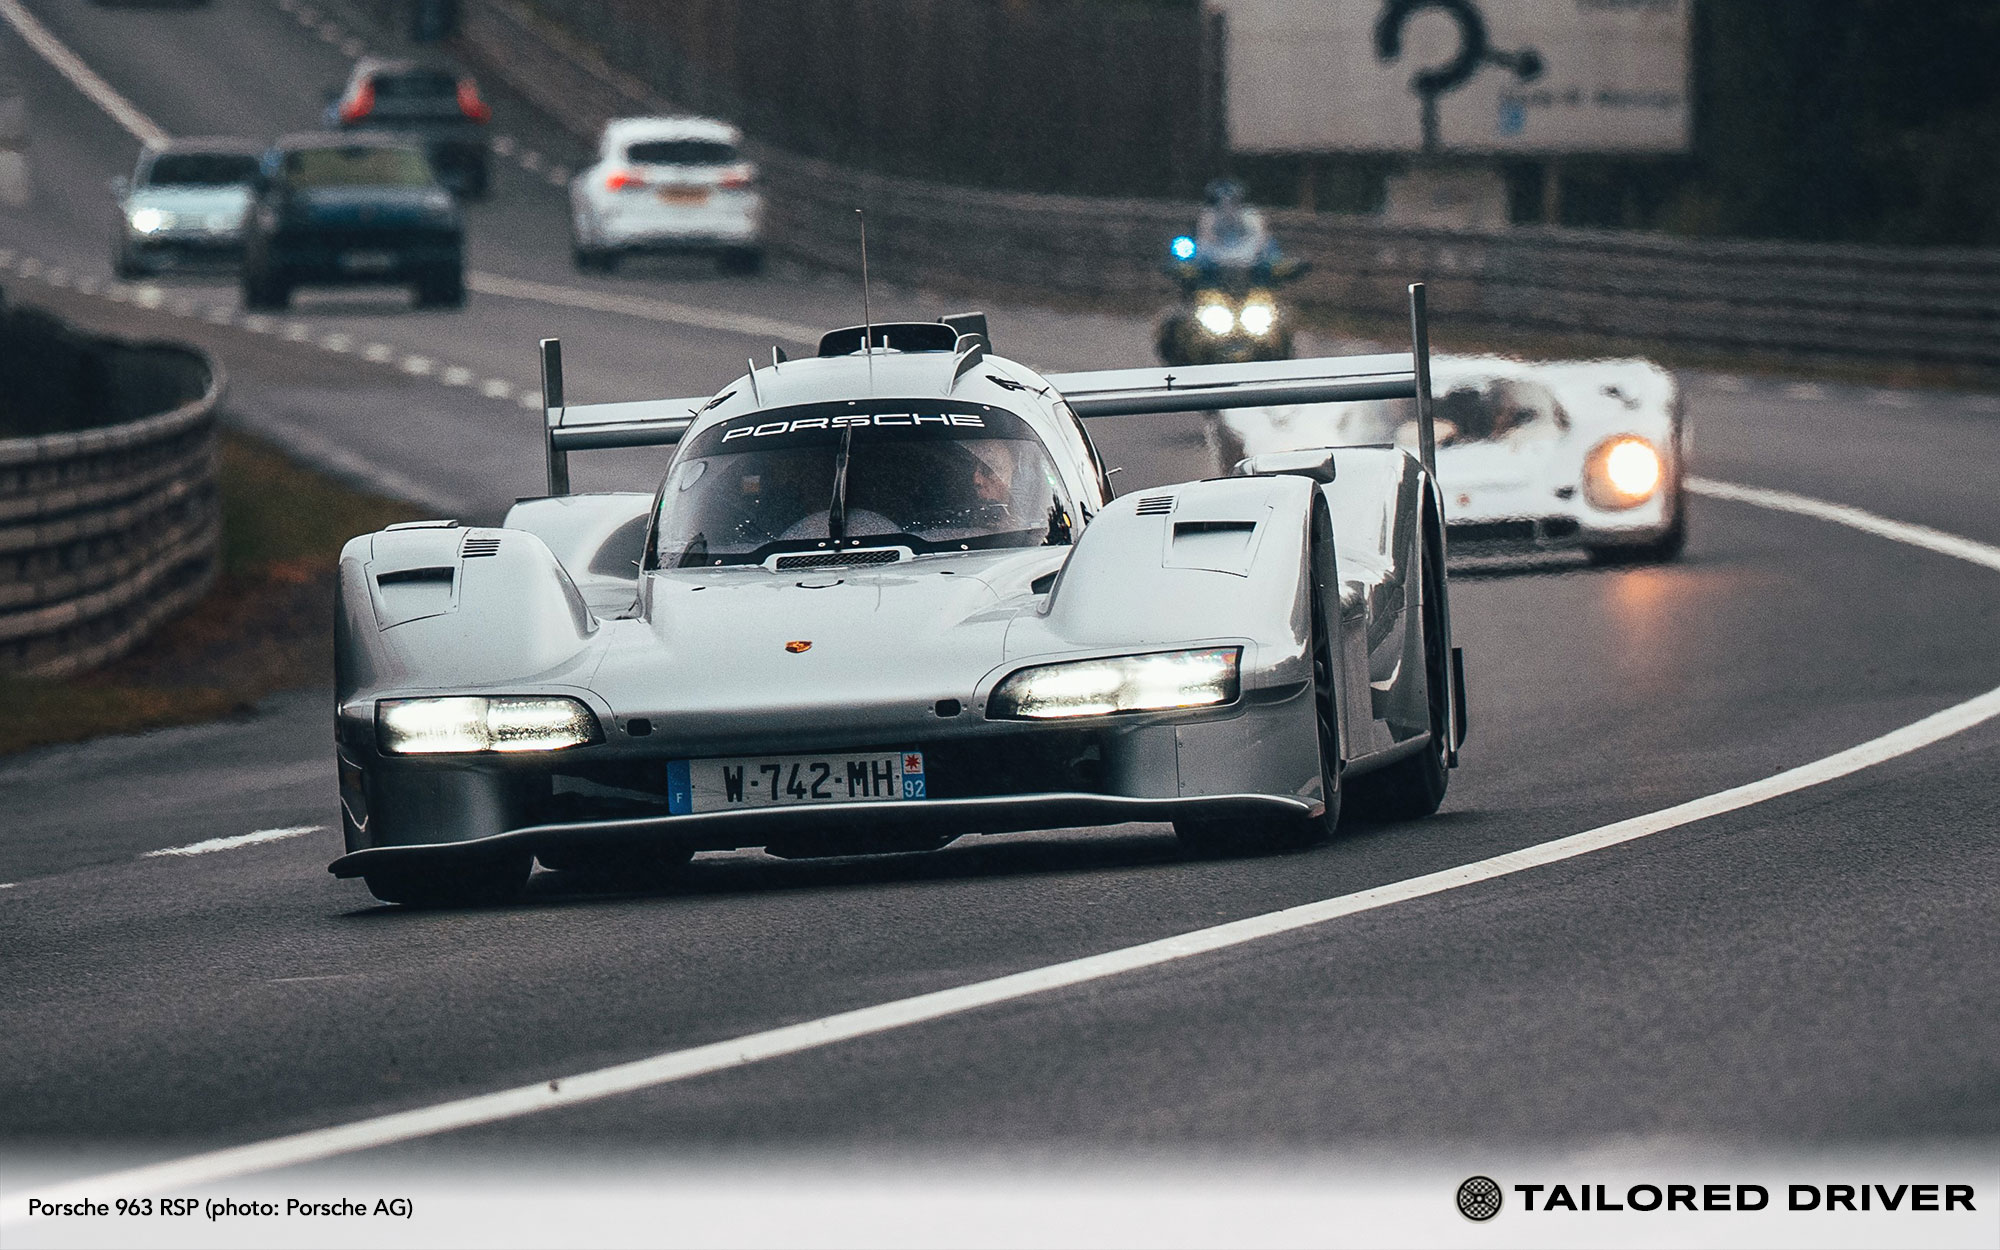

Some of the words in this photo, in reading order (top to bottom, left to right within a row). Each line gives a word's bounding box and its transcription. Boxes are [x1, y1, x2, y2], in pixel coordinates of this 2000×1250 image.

[721, 413, 986, 443] PORSCHE
[676, 792, 683, 804] F
[904, 780, 925, 798] 92
